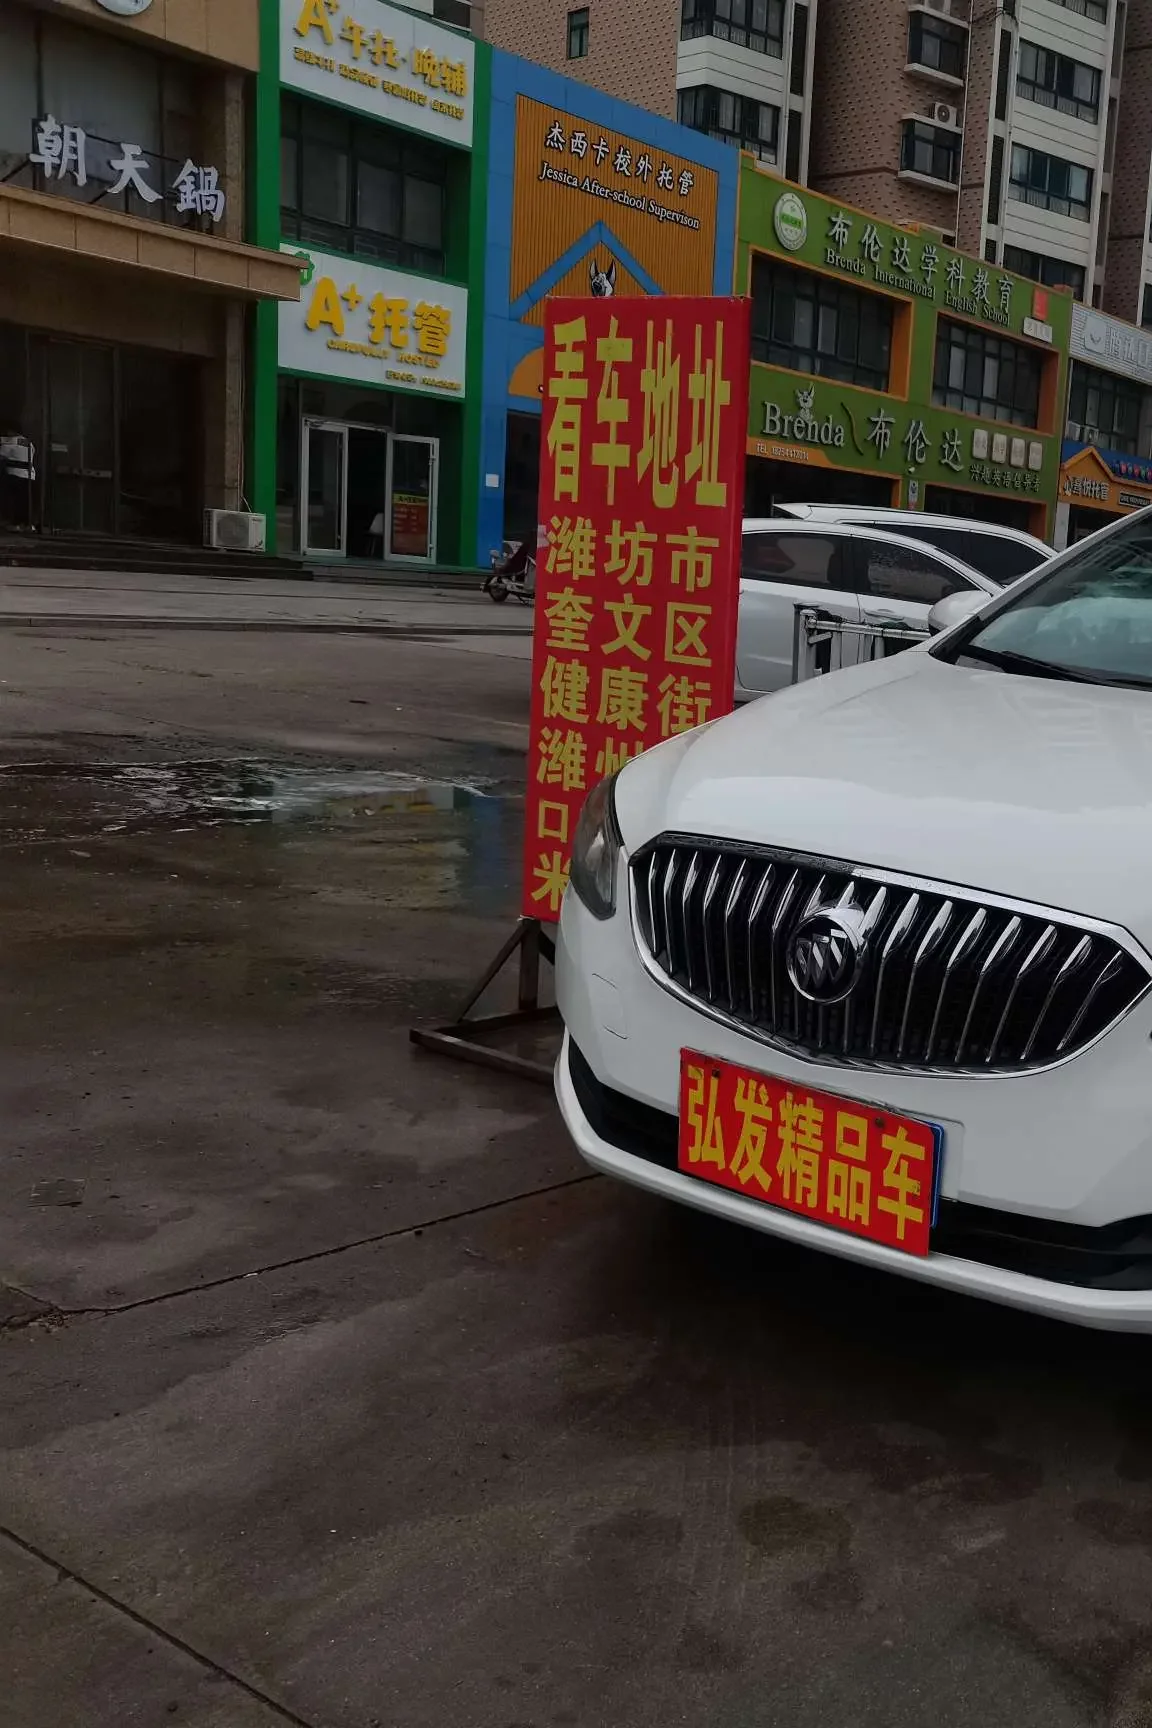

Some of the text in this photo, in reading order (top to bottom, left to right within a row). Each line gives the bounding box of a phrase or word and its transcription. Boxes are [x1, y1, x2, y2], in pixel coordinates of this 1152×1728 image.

[538, 162, 700, 230] Jessica After-school Supervison
[545, 121, 695, 197] 杰西卡校外托管
[825, 247, 1011, 326] Brenda International English School
[827, 210, 1015, 314] 布伦达学科教育
[547, 315, 731, 508] 看车地址
[762, 401, 845, 448] Brenda
[866, 407, 964, 472] 布伦达
[544, 515, 719, 592] 潍坊市
[544, 588, 712, 668] 奎文区
[540, 655, 712, 735] 健康街
[687, 1065, 926, 1240] 弘发精品车
